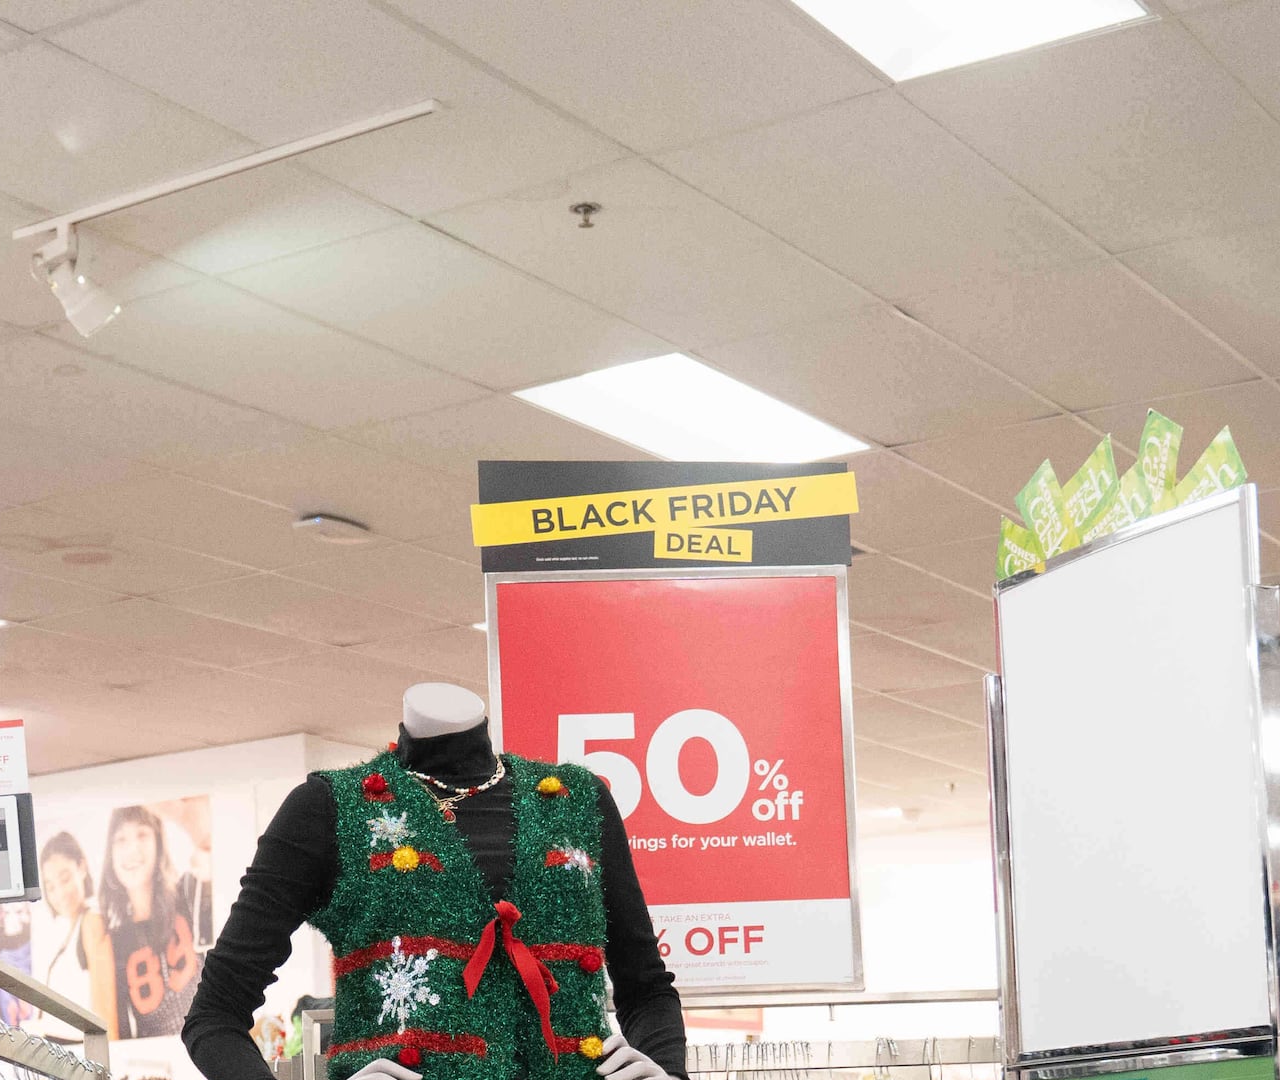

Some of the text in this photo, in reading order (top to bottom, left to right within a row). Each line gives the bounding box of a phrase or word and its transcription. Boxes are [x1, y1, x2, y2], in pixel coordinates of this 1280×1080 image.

[531, 486, 797, 534] BLACK FRIDAY
[666, 532, 741, 555] DEAL
[557, 708, 750, 825] 50
[754, 759, 789, 791] %
[751, 791, 804, 821] off
[671, 834, 695, 849] for
[701, 835, 738, 851] your
[742, 832, 797, 848] wallet.
[660, 915, 682, 923] TAKE
[685, 914, 699, 922] AN
[700, 913, 731, 922] EXTRA
[685, 925, 765, 956] OFF
